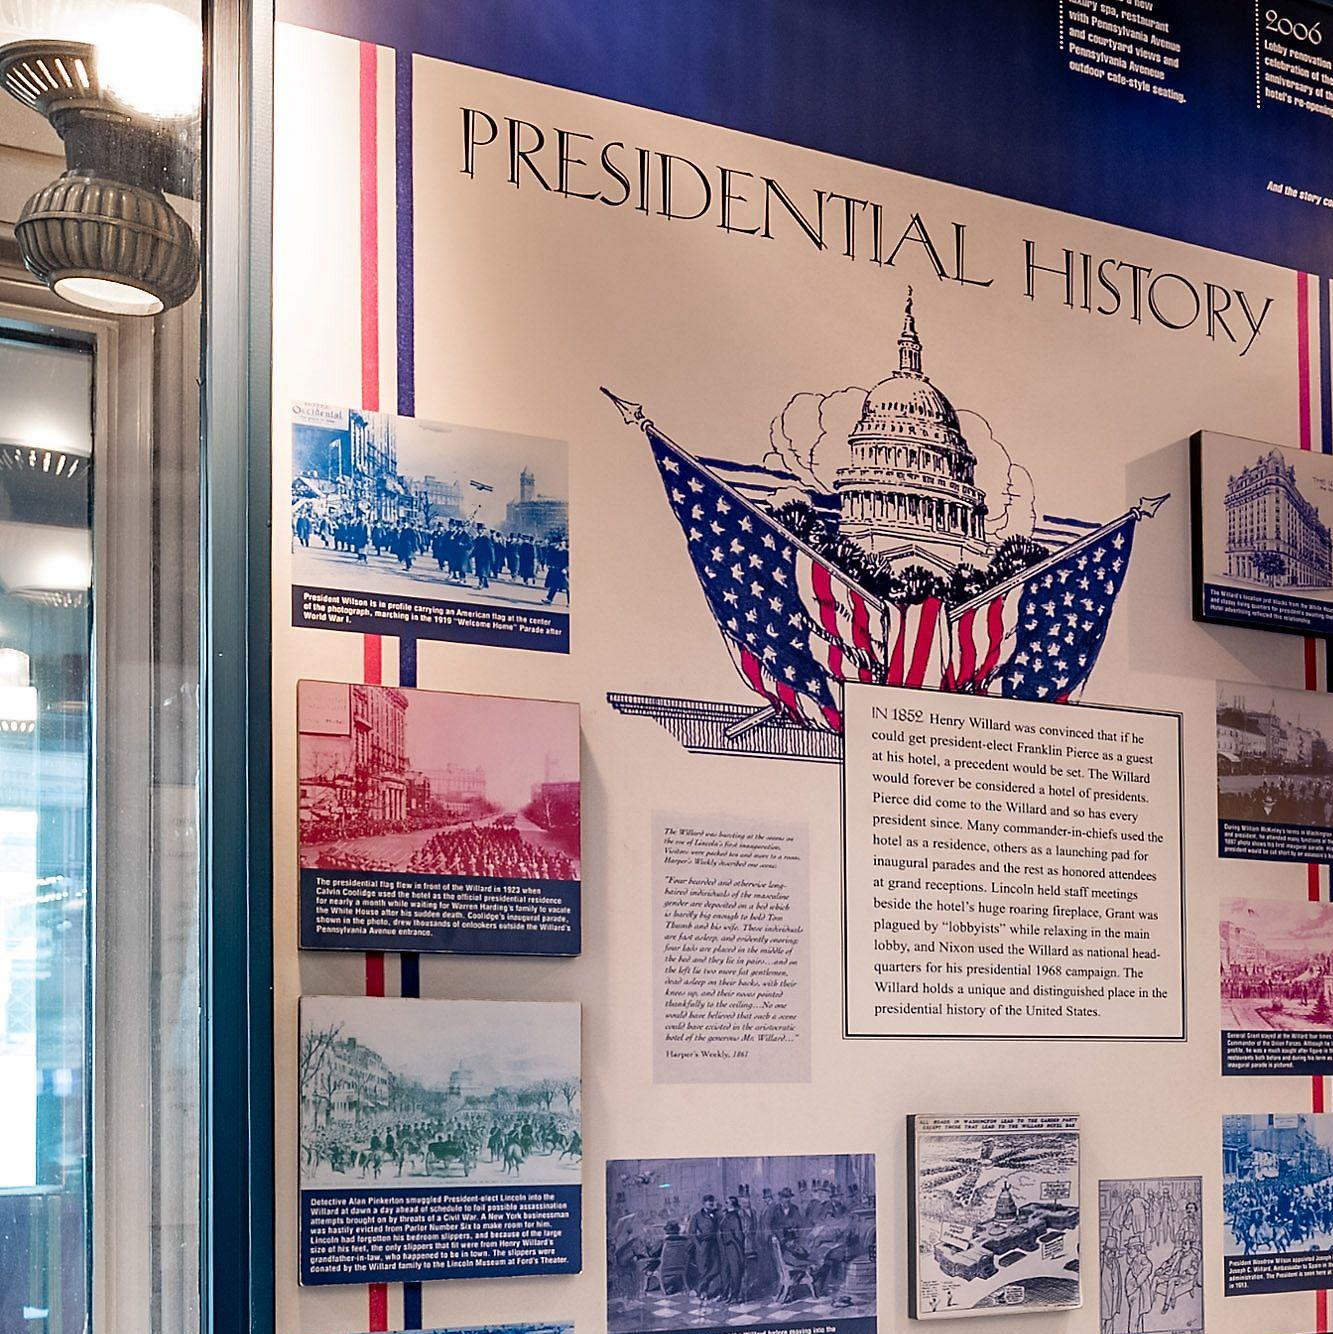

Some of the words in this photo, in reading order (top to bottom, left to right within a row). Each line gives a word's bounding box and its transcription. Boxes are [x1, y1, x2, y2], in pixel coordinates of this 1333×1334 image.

[1068, 10, 1089, 24] with
[1091, 16, 1148, 43] Pennsylvania
[1150, 35, 1181, 53] Avenue
[1100, 3, 1119, 18] spa,
[1121, 10, 1169, 33] restaurant
[1265, 9, 1322, 45] 2006
[1068, 27, 1086, 40] and
[1087, 33, 1133, 54] courtyard
[1135, 47, 1161, 63] views
[1163, 56, 1179, 69] and
[1068, 42, 1127, 69] Pennsylvania
[1264, 39, 1288, 57] Lobby
[1289, 49, 1332, 70] renovation
[1069, 60, 1105, 78] outdoor
[1152, 85, 1187, 104] seating.
[1264, 57, 1310, 78] celebration
[1311, 71, 1319, 81] of
[1321, 74, 1333, 86] the
[1264, 72, 1313, 96] anniversary
[1315, 87, 1324, 98] of
[1265, 86, 1292, 104] hotel's
[1267, 180, 1283, 194] And
[1284, 186, 1298, 197] the
[1299, 190, 1322, 205] story
[458, 106, 993, 288] PRESIDENTIAL
[1022, 239, 1275, 357] HISTORY
[871, 706, 887, 719] IN
[893, 708, 923, 722] 1852
[929, 713, 965, 729] Henry
[968, 717, 1010, 731] Willard
[1013, 724, 1036, 733] was
[1038, 726, 1094, 738] convinced
[1097, 729, 1117, 741] that
[1120, 731, 1130, 742] if
[1131, 732, 1144, 744] he
[871, 730, 904, 741] could
[908, 735, 926, 745] get
[929, 736, 1012, 751] president-elect
[1016, 741, 1062, 755] Franklin
[1065, 746, 1099, 759] Pierce
[1101, 752, 1113, 760] as
[1116, 753, 1122, 761] a
[1125, 755, 1153, 765] guest
[871, 751, 882, 760] at
[886, 750, 904, 762] his
[907, 752, 940, 766] hotel,
[943, 758, 950, 766] a
[954, 759, 1008, 771] precedent
[1012, 763, 1046, 774] would
[1049, 764, 1063, 776] be
[1065, 769, 1084, 777] set.
[1087, 768, 1108, 780] The
[1111, 770, 1150, 783] Willard
[872, 772, 909, 784] would
[913, 773, 954, 787] forever
[957, 777, 971, 789] be
[974, 781, 1035, 793] considered
[1048, 784, 1075, 796] hotel
[1078, 787, 1091, 798] of
[1092, 790, 1148, 802] presidents.
[872, 791, 909, 804] Pierce
[912, 794, 931, 806] did
[934, 799, 966, 808] come
[969, 801, 981, 809] to
[984, 800, 1002, 811] the
[1005, 801, 1047, 814] Willard
[1049, 806, 1069, 816] and
[1072, 809, 1085, 817] so
[1088, 807, 1106, 818] has
[1108, 812, 1138, 824] every
[872, 814, 926, 826] president
[930, 816, 962, 829] since.
[966, 819, 999, 834] Many
[1002, 825, 1117, 838] commander-in-chiefs
[1120, 831, 1144, 841] used
[1147, 831, 1163, 842] the
[872, 833, 902, 846] hotel
[905, 838, 918, 846] as
[922, 839, 929, 847] a
[932, 838, 989, 852] residence,
[992, 842, 1027, 853] others
[1030, 846, 1042, 854] as
[1045, 847, 1052, 855] a
[1055, 845, 1108, 861] launching
[1110, 849, 1130, 862] pad
[1133, 849, 1148, 861] for
